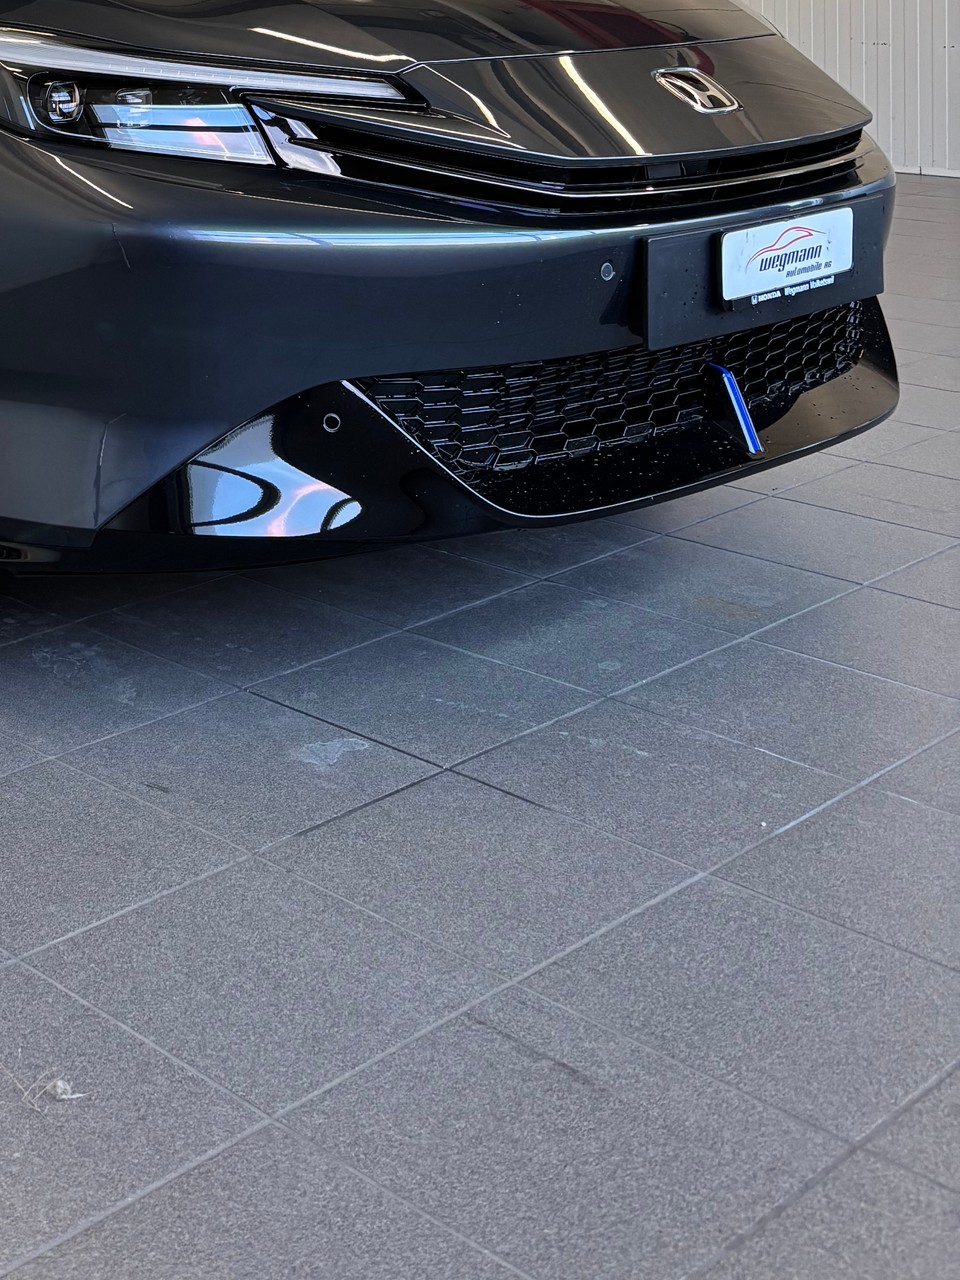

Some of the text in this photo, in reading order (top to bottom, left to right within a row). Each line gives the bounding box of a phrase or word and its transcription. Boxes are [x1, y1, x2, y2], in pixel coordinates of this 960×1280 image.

[759, 245, 822, 272] wegmann
[824, 260, 832, 269] AG
[758, 290, 781, 302] HONDA
